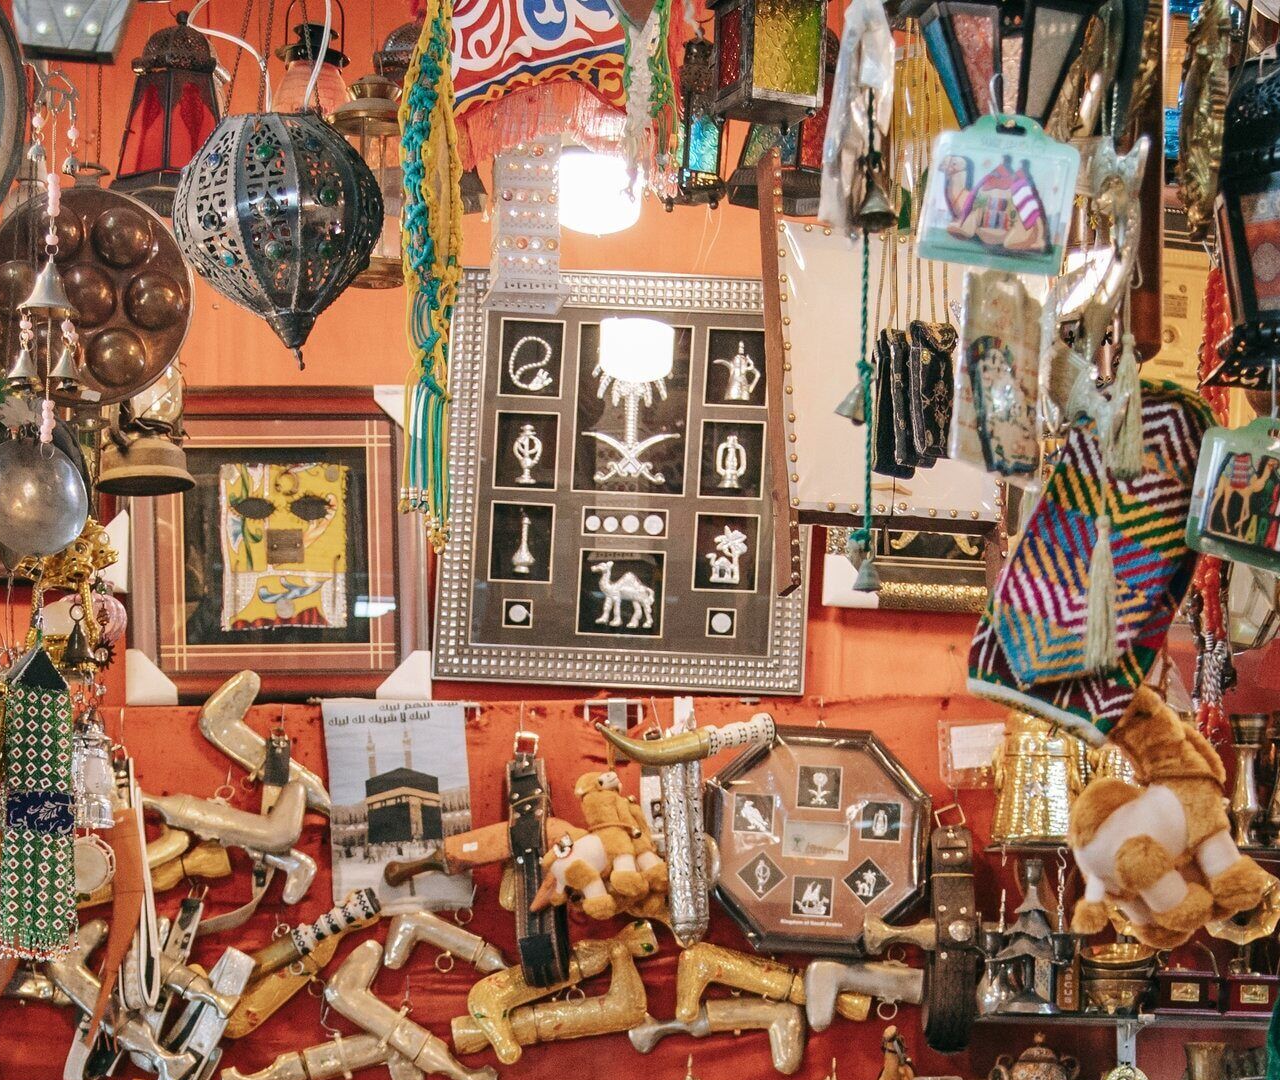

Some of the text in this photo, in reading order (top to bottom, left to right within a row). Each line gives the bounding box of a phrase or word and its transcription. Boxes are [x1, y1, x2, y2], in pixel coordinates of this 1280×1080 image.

[327, 715, 350, 727] لبيك
[368, 713, 398, 725] شريك
[399, 711, 407, 723] لا
[408, 710, 431, 721] لبيك
